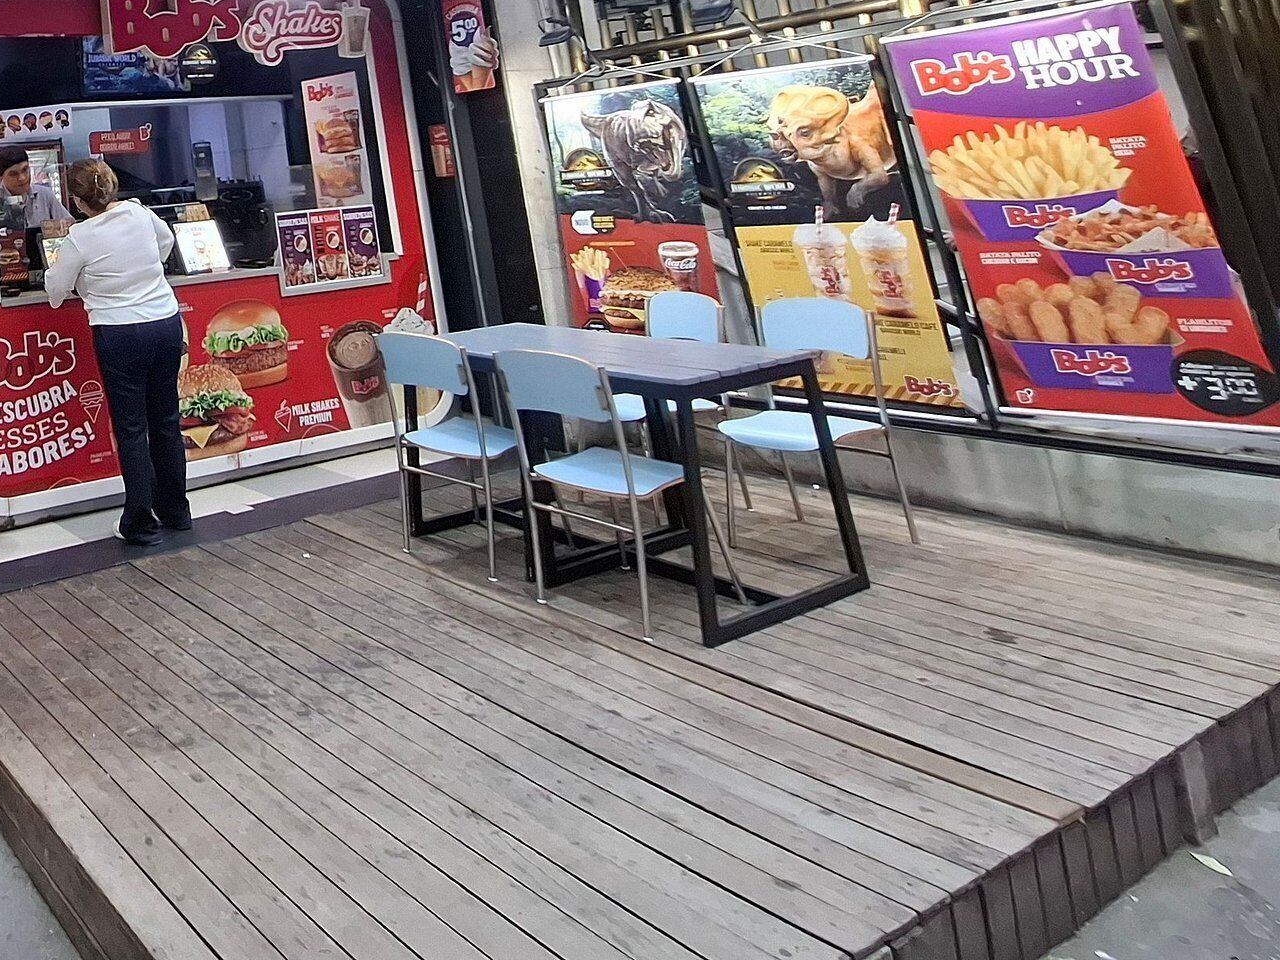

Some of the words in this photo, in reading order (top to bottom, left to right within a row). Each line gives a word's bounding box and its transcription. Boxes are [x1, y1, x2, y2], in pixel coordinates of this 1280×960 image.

[245, 1, 343, 64] Shakes
[910, 51, 1015, 96] Bob's
[1011, 26, 1123, 66] HAPPY
[1019, 53, 1140, 90] HOUR
[307, 83, 334, 102] Bob's
[1002, 204, 1077, 229] Bob's
[1105, 258, 1193, 284] Bob's
[1050, 349, 1131, 376] Bob's
[904, 374, 953, 396] Bob's
[292, 403, 311, 416] MILK
[311, 398, 340, 412] SHAKES
[299, 411, 333, 427] PREMIUM
